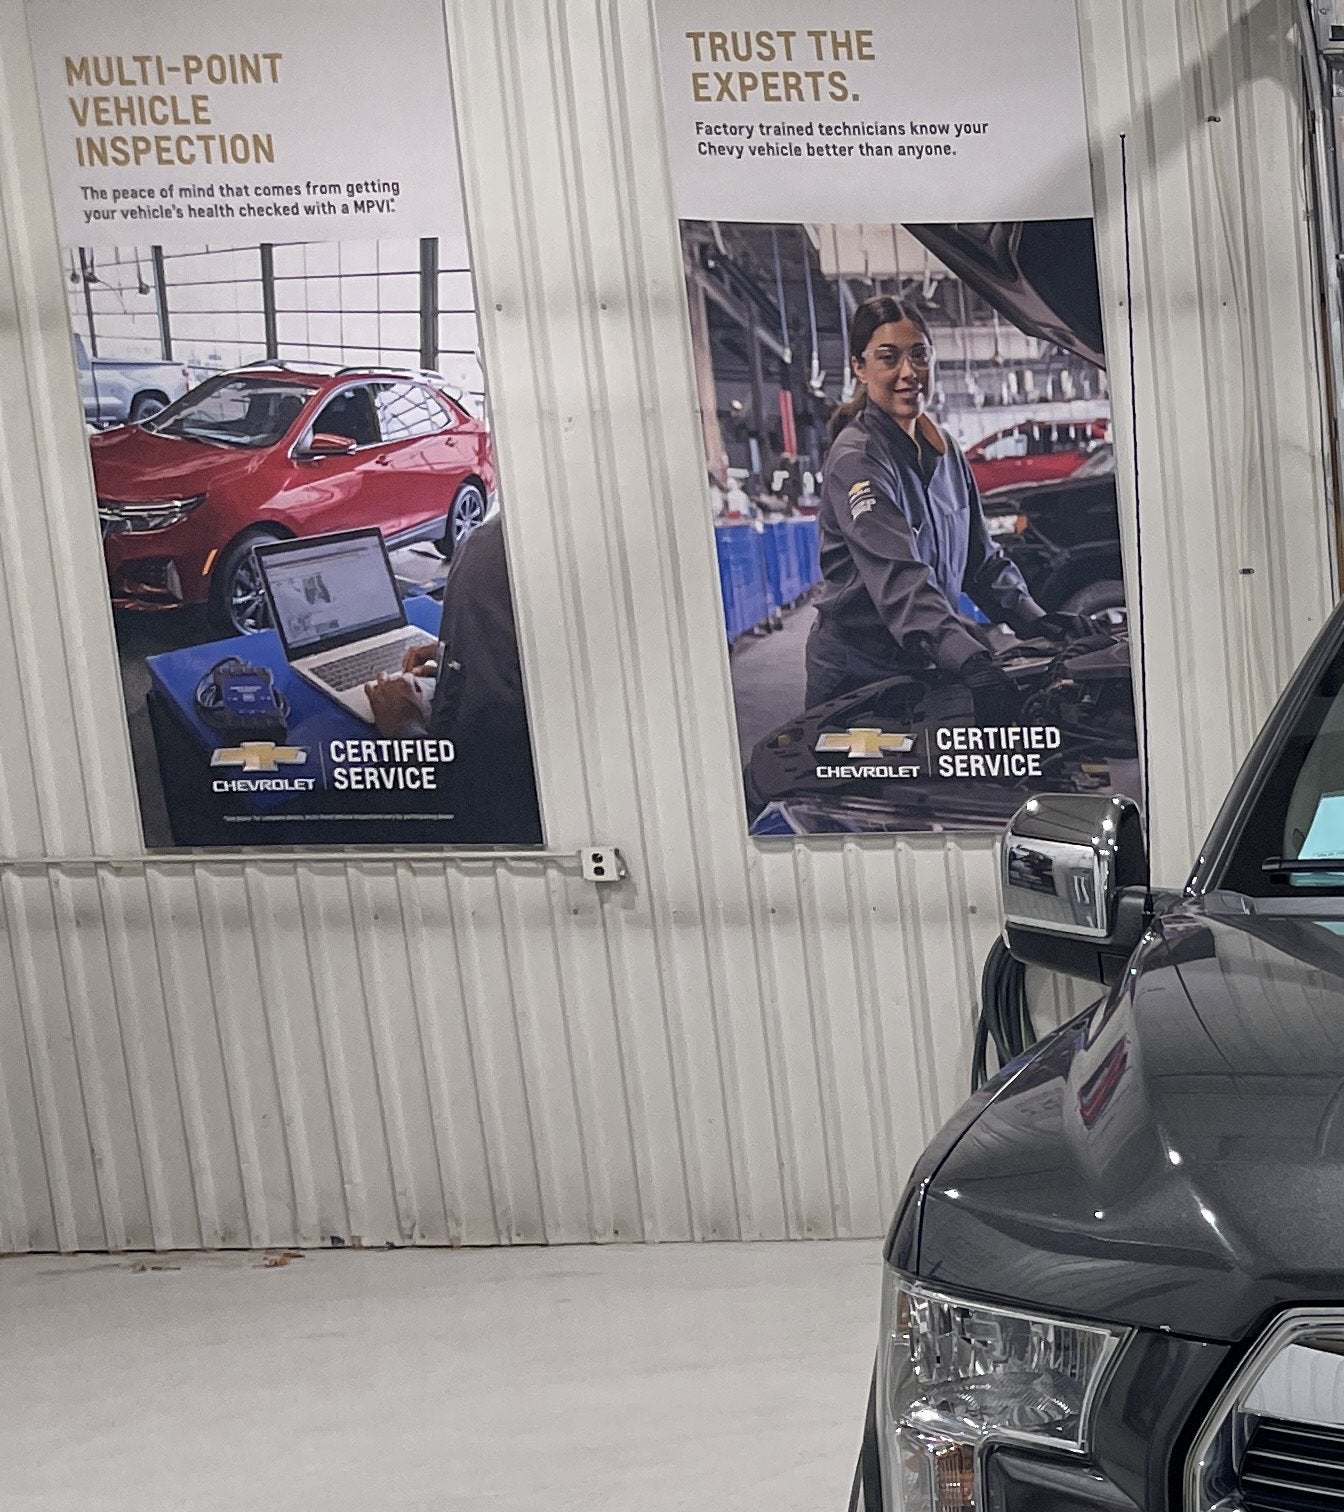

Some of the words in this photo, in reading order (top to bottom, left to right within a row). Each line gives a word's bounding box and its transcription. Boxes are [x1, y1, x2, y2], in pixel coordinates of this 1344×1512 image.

[686, 31, 797, 62] TRUST
[808, 30, 875, 61] THE
[64, 52, 283, 87] MULTI-POINT
[691, 70, 860, 102] EXPERTS.
[68, 95, 211, 127] VEHICLE
[695, 121, 754, 139] Factory
[759, 121, 814, 136] trained
[818, 121, 906, 136] technicians
[910, 121, 950, 135] know
[954, 122, 989, 138] your
[76, 133, 275, 167] INSPECTION
[698, 141, 744, 159] Chevy
[749, 141, 802, 156] vehicle
[806, 142, 854, 156] better
[859, 142, 893, 156] than
[898, 144, 957, 159] anyone.
[81, 186, 108, 200] The
[112, 187, 156, 204] peace
[159, 184, 174, 199] of
[178, 184, 215, 198] mind
[218, 183, 250, 198] that
[254, 185, 301, 197] comes
[306, 181, 342, 196] from
[346, 179, 400, 198] getting
[83, 208, 117, 224] your
[120, 204, 184, 220] vehicle's
[187, 203, 235, 218] health
[239, 202, 300, 217] checked
[304, 201, 337, 216] with
[341, 204, 350, 215] a
[936, 726, 1061, 751] CERTIFIED
[330, 739, 456, 764] CERTIFIED
[816, 765, 920, 779] CHEVROLET
[938, 753, 1042, 777] SERVICE
[212, 777, 316, 793] CHEVROLET
[333, 766, 437, 791] SERVICE
